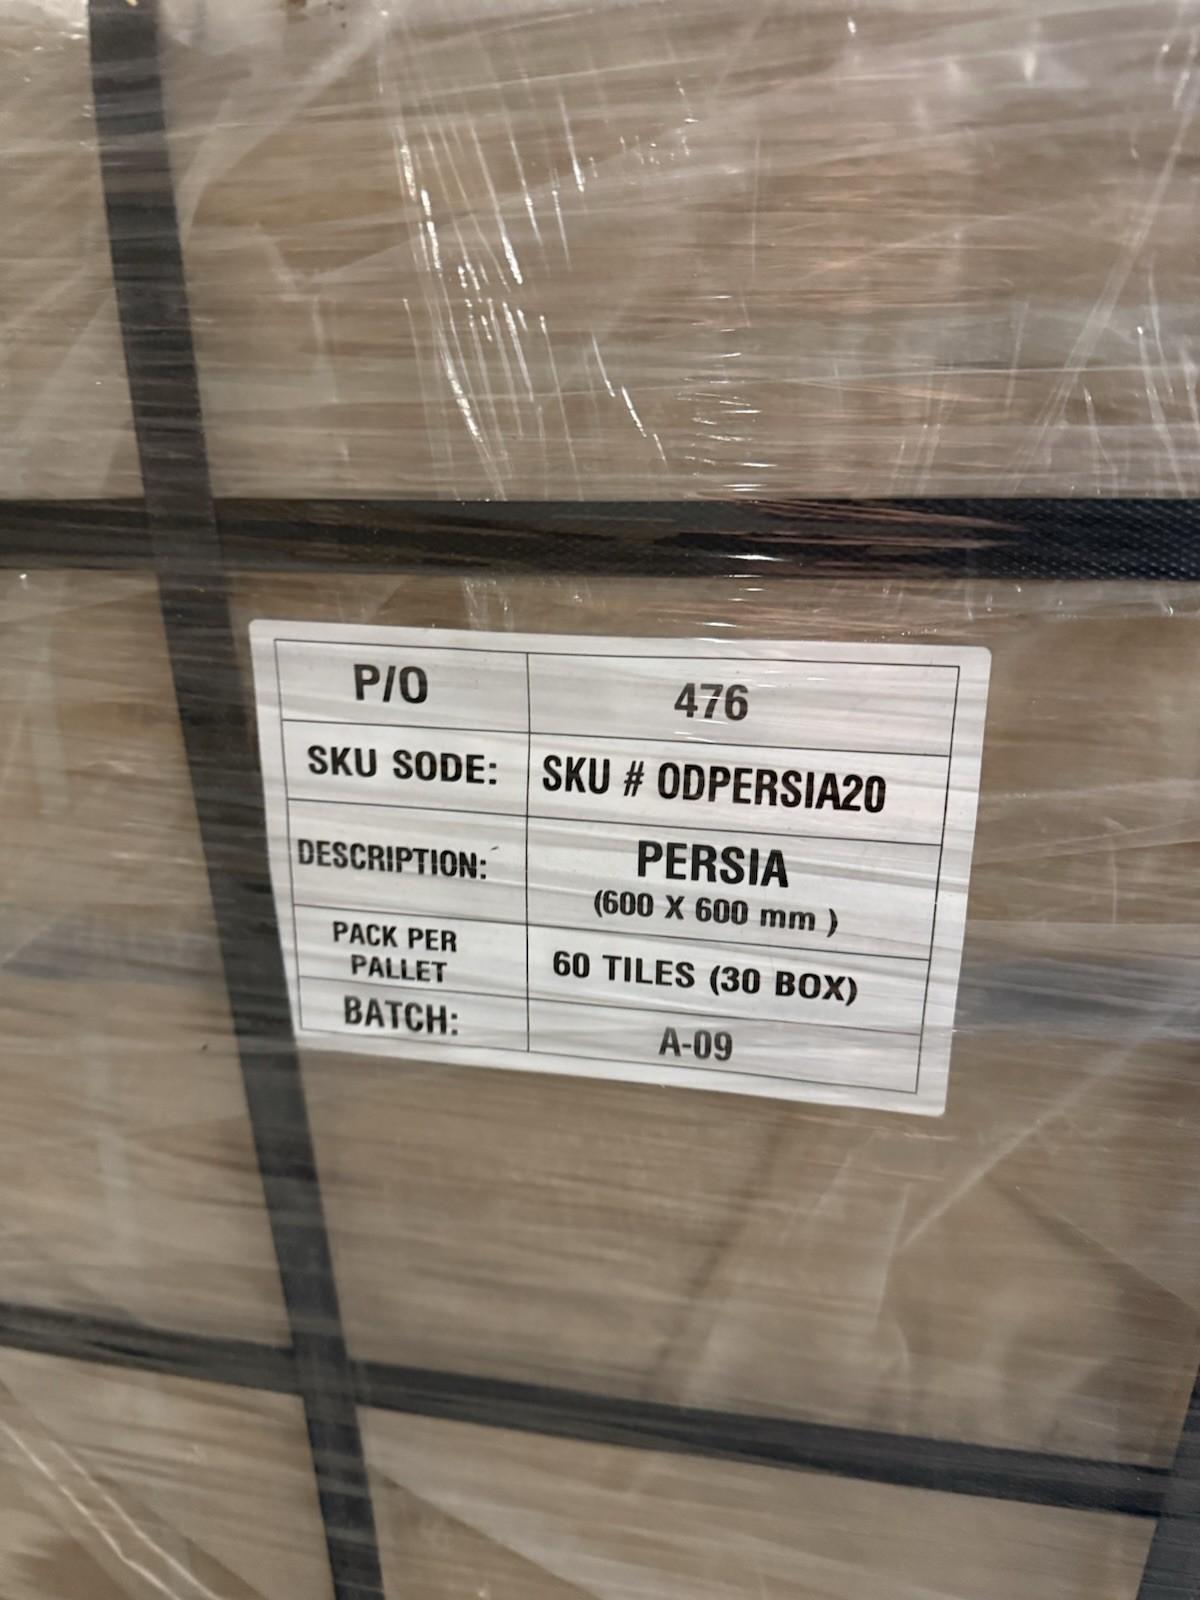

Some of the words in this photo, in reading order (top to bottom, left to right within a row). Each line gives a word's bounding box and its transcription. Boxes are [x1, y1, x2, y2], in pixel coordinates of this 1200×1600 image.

[353, 663, 429, 705] P/O
[673, 682, 749, 723] 476
[307, 744, 378, 778] SKU
[392, 748, 498, 787] SODE:
[542, 754, 611, 795] SKU
[623, 760, 645, 798] #
[297, 838, 487, 882] DESCRIPTION:
[637, 840, 789, 889] PERSIA
[593, 889, 656, 918] (600
[664, 894, 686, 921] X
[694, 896, 749, 926] 600
[759, 906, 816, 933] mm
[826, 907, 839, 937] )
[332, 921, 399, 949] PACK
[407, 927, 457, 954] PER
[350, 954, 448, 985] PALLET
[552, 950, 591, 979] 60
[601, 954, 696, 990] TILES
[709, 964, 762, 996] (30
[774, 970, 859, 1008] BOX)
[343, 995, 459, 1036] BATCH:
[658, 1027, 733, 1063] A-09
